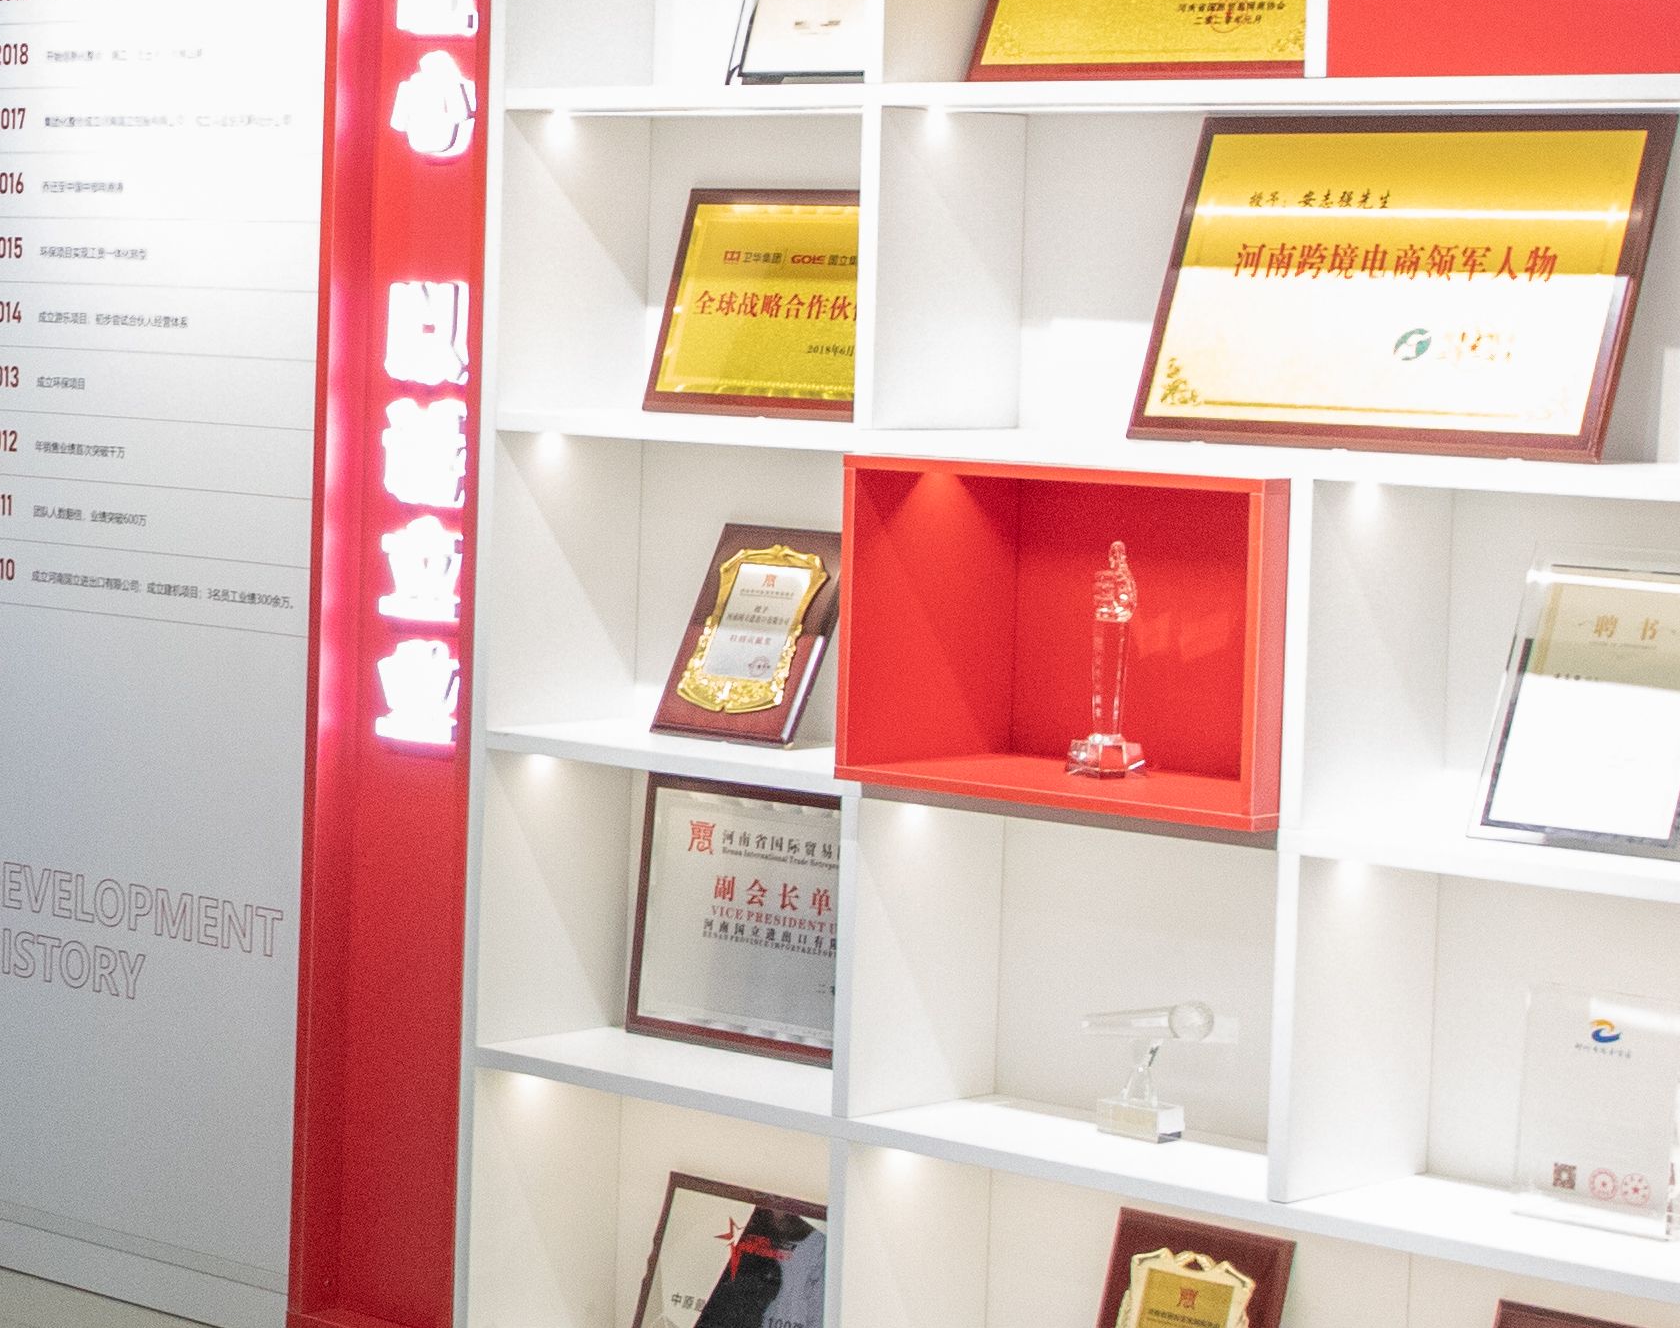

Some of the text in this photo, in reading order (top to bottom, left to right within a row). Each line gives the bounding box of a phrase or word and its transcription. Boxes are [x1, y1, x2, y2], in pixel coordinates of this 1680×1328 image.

[1234, 241, 1558, 284] 河南跨境电商领军人物
[694, 289, 857, 321] 全球战略合作伙
[36, 376, 85, 391] 成立环保项目
[722, 829, 840, 862] 河南省国际贸易
[714, 875, 833, 917] 副会长单
[711, 905, 743, 920] VICE
[746, 909, 826, 932] PRESIDENT
